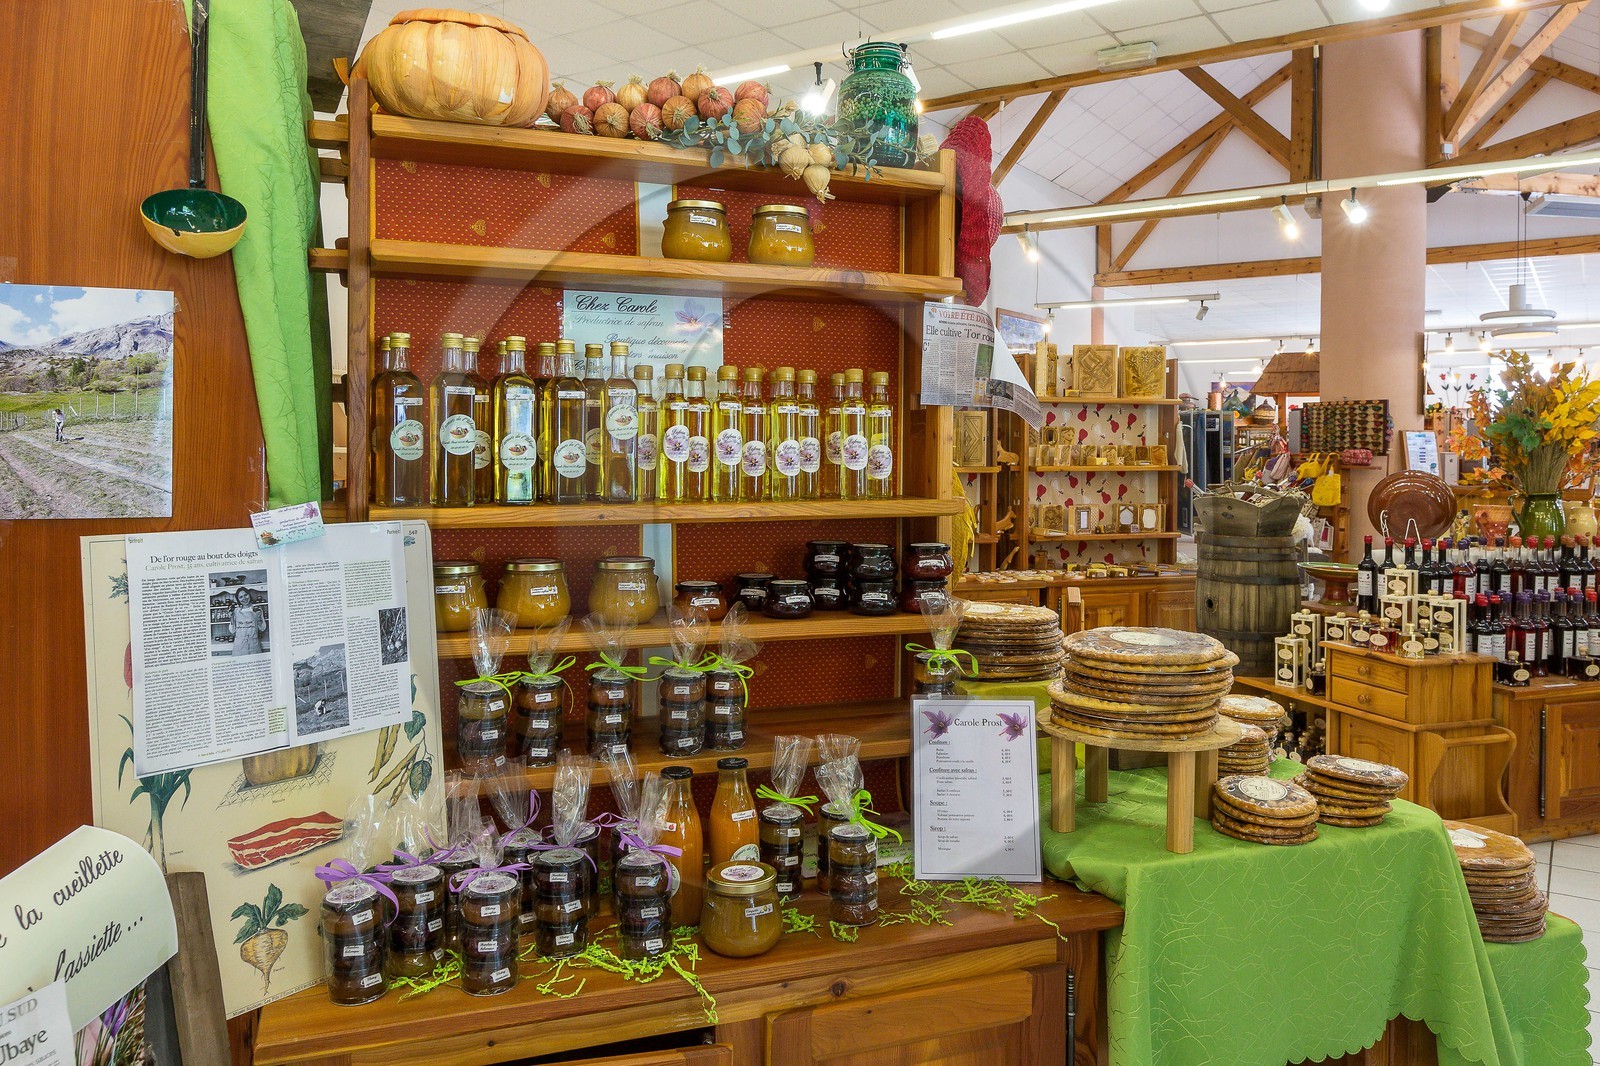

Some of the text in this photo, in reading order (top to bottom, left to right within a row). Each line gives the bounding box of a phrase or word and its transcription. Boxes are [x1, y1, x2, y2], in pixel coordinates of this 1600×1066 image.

[576, 294, 658, 313] Chez Carole
[961, 311, 974, 321] ÉTÉ
[573, 316, 664, 332] Productrice de safran
[926, 325, 938, 336] Elle
[940, 327, 962, 338] cultive
[605, 333, 645, 346] Boutique
[150, 556, 162, 564] De
[163, 554, 175, 563] l'or
[175, 555, 196, 565] rouge
[237, 550, 258, 559] doigts
[206, 560, 237, 568] cultivatrice
[954, 718, 979, 726] Carole
[14, 849, 124, 930] la cueillette
[7, 998, 38, 1022] SUD
